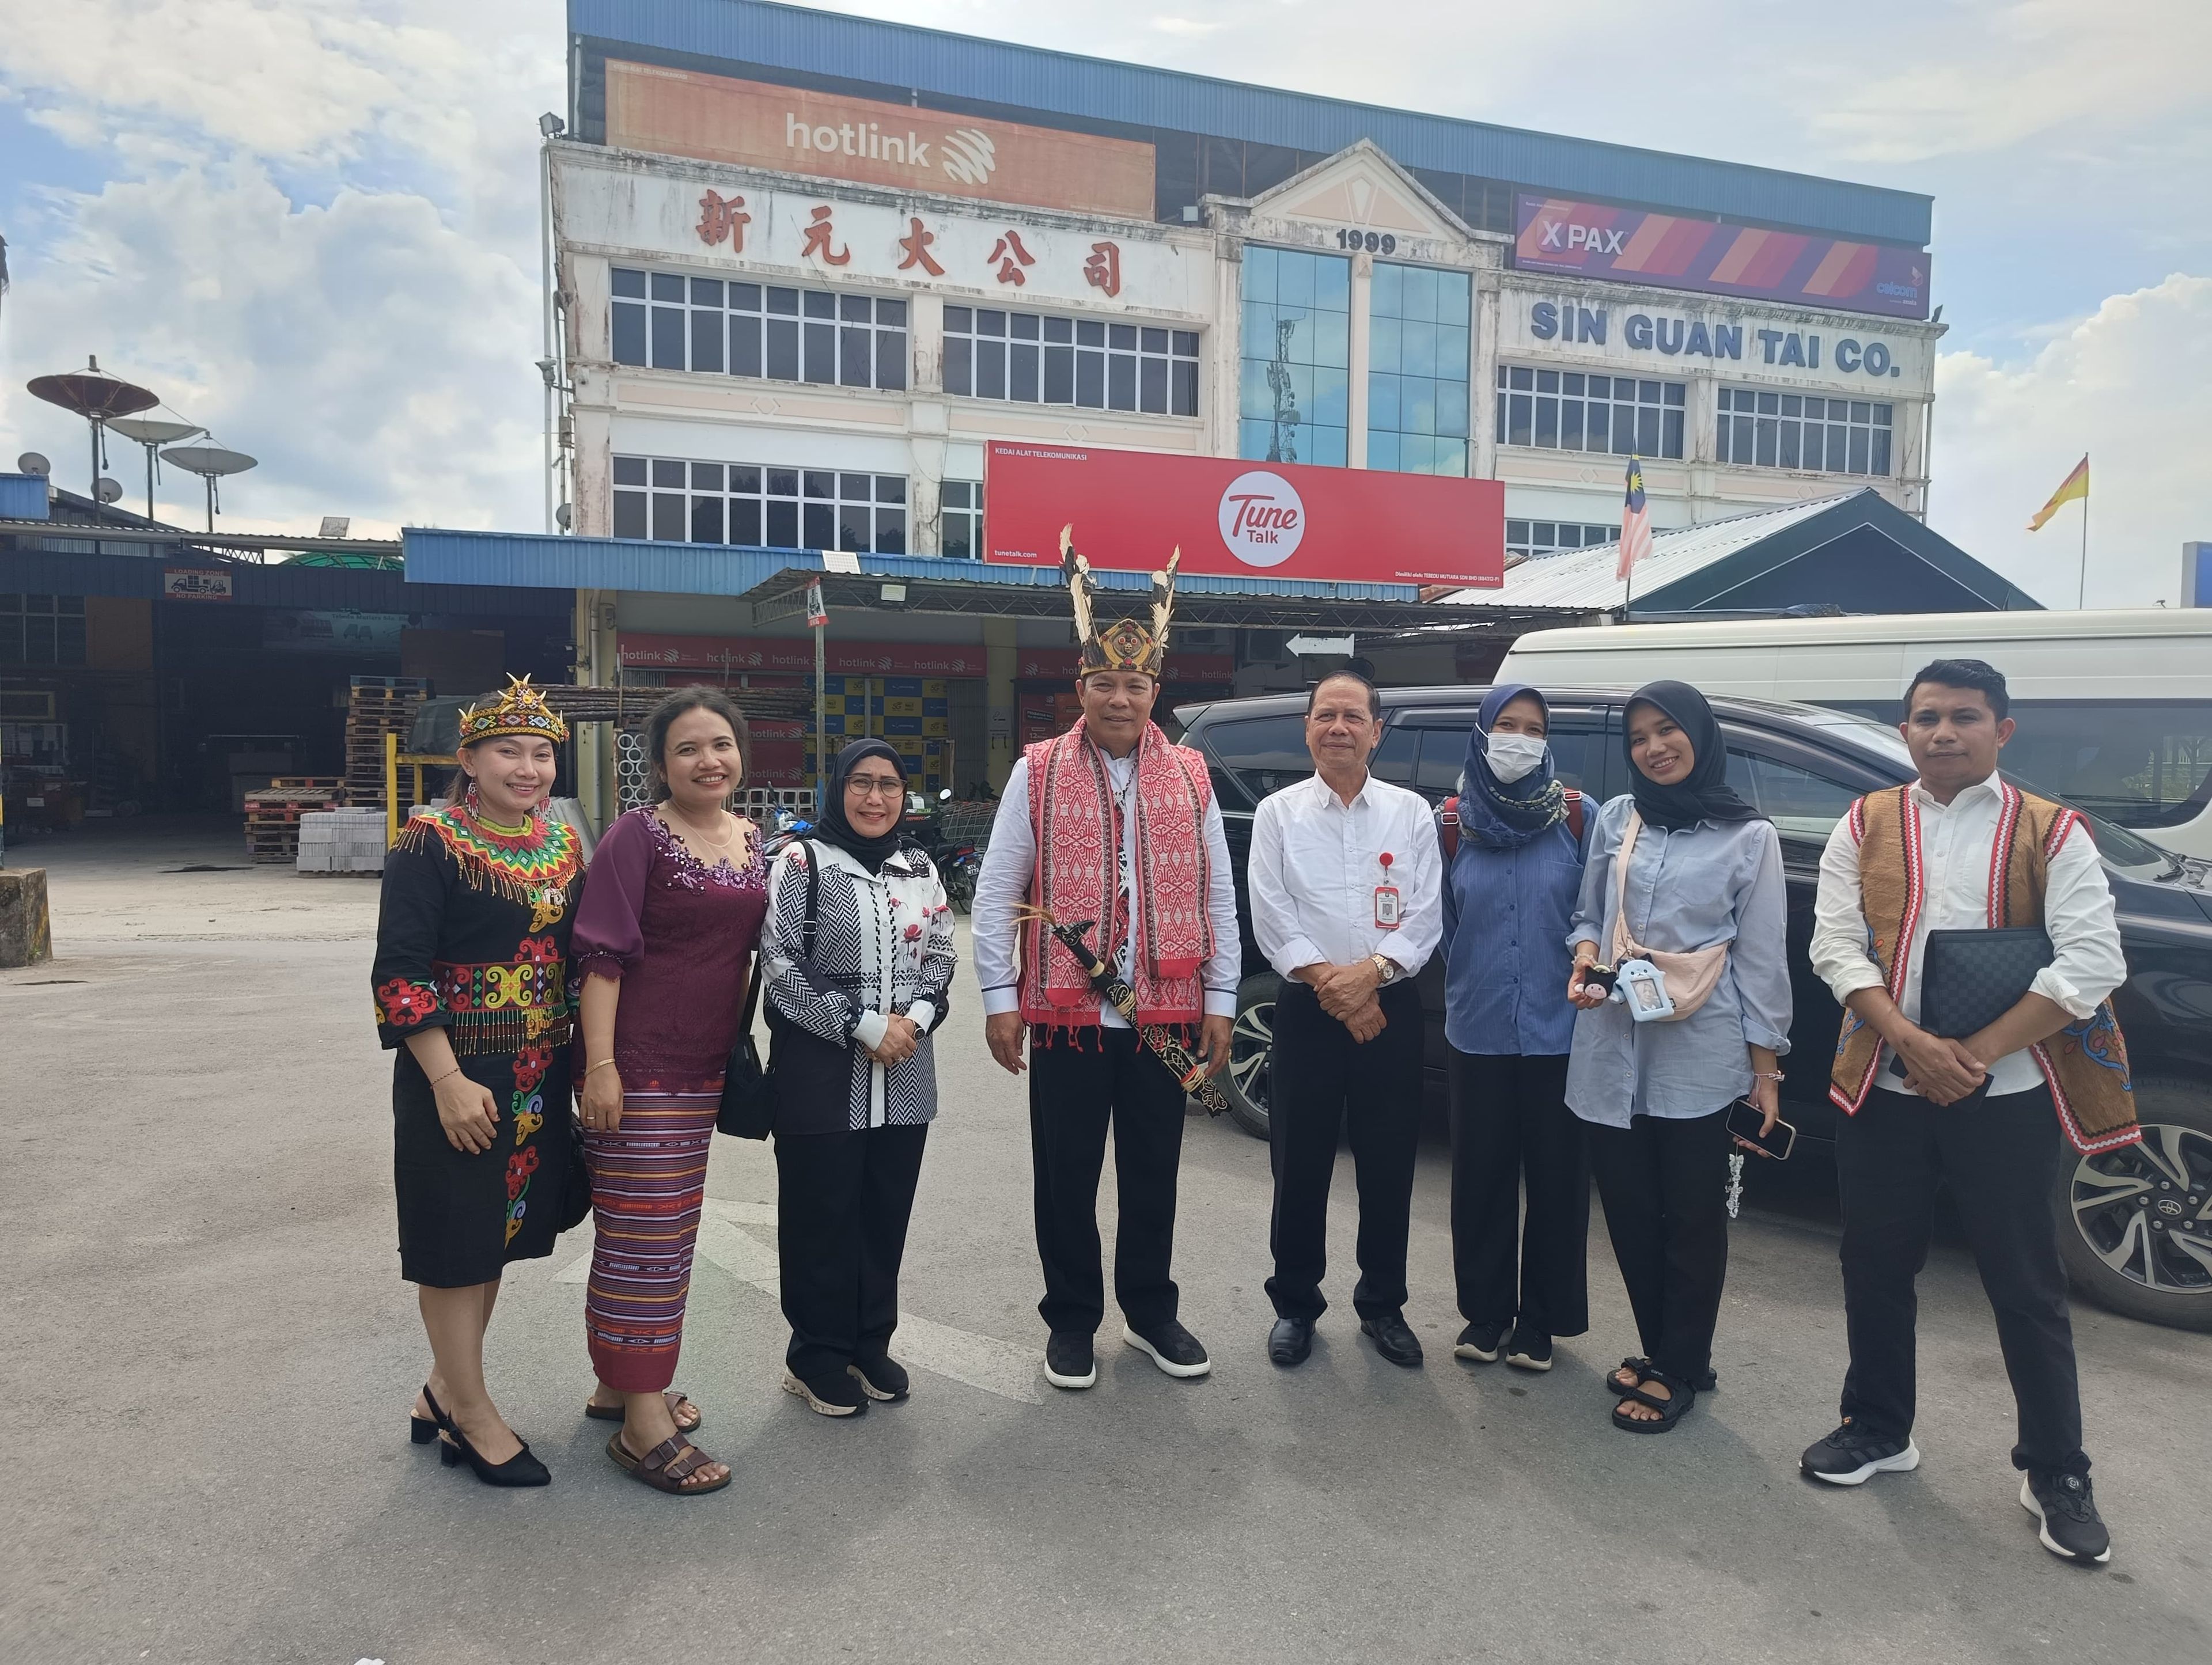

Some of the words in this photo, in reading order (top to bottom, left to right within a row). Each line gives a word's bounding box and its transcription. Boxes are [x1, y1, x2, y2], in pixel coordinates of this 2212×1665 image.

[787, 112, 931, 168] hotlink
[696, 188, 1121, 298] 新元大公司
[1336, 229, 1396, 255] 1999
[1568, 224, 1624, 256] PAX
[1531, 302, 1607, 345] SIN
[1624, 314, 1742, 360] GUAN
[1758, 329, 1820, 369] TAI
[1835, 339, 1900, 377] CO.
[995, 447, 1015, 456] KEDAI
[1032, 450, 1087, 461] TELEKOMUNIKASI
[1229, 495, 1298, 537] Tune
[1247, 530, 1278, 544] Talk
[995, 549, 1037, 557] tunetalk.com
[772, 654, 809, 665] hotlink
[839, 657, 875, 668] hotlink
[914, 660, 949, 670] hotlink
